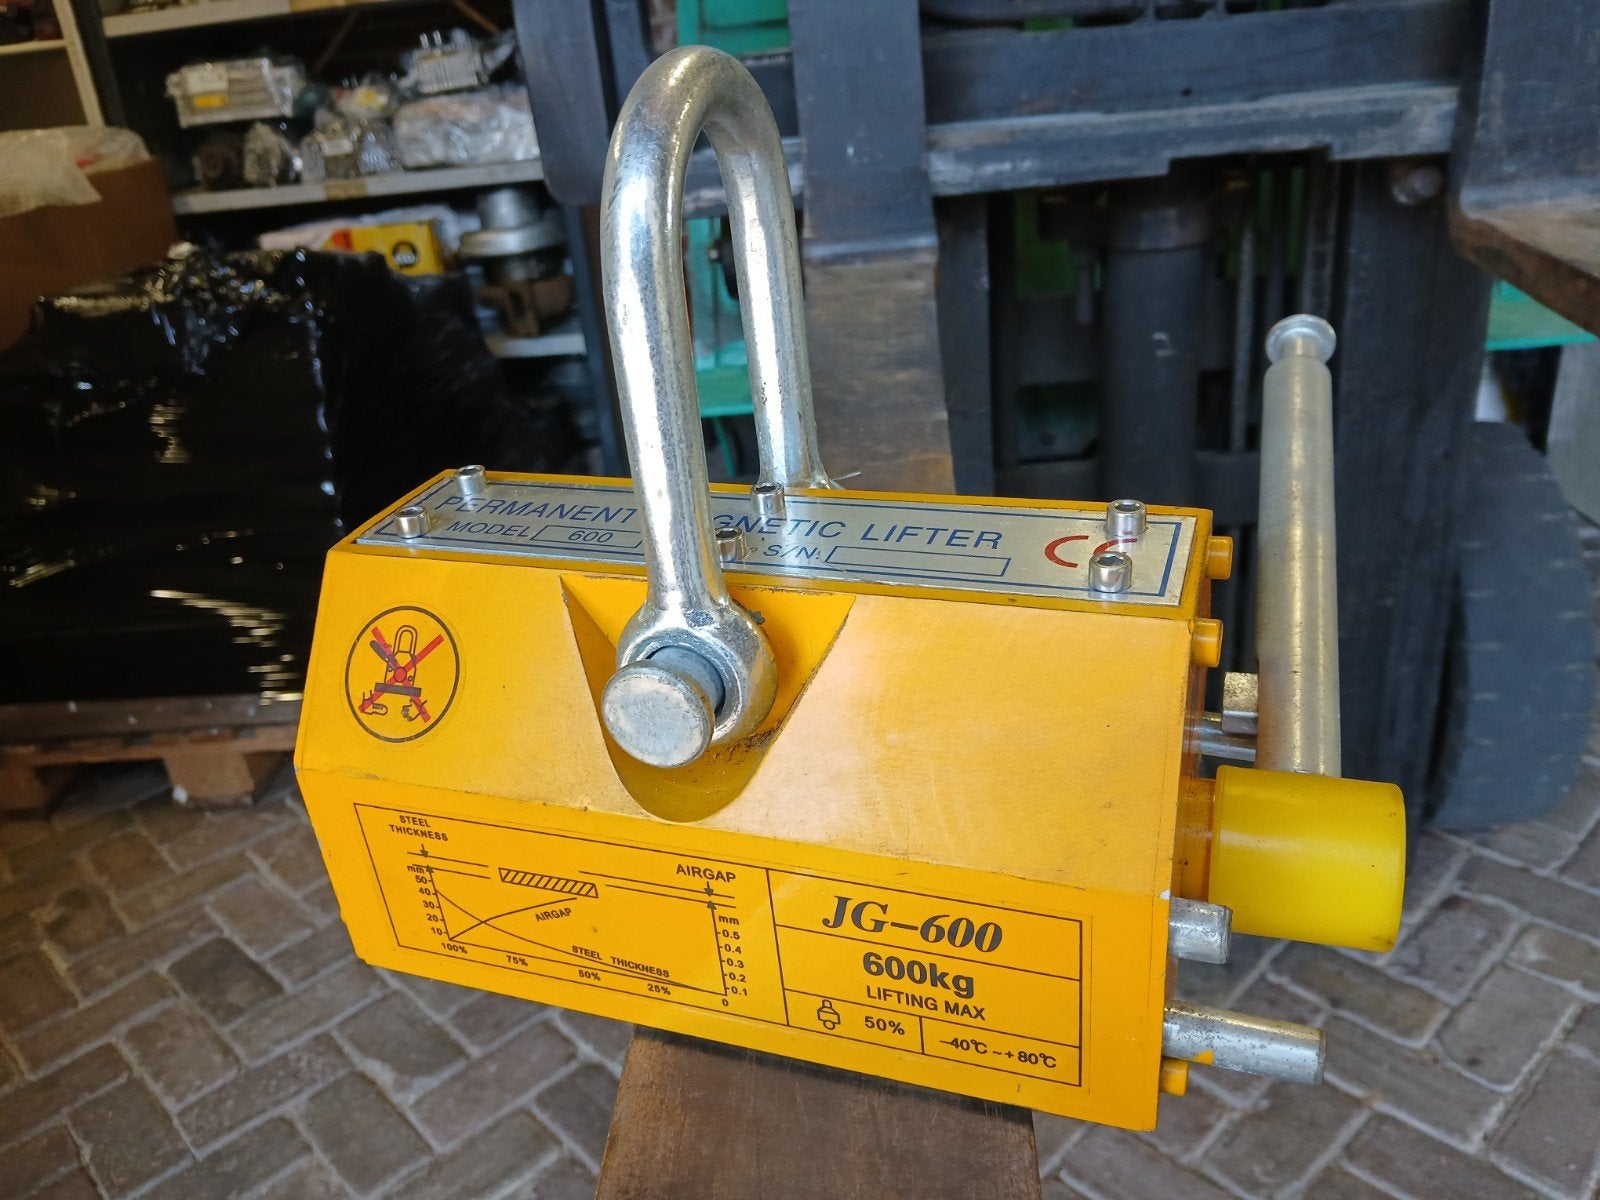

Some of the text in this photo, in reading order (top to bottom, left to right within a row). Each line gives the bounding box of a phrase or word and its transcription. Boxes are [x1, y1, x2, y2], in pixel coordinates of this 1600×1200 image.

[446, 521, 531, 538] MODEL
[568, 530, 613, 543] 600
[713, 514, 846, 539] GNETIC
[860, 523, 1003, 550] LIFTER
[399, 815, 431, 828] STEEL
[389, 824, 448, 841] THICKNESS
[407, 865, 424, 874] mm
[675, 863, 736, 883] AIRGAP
[415, 875, 427, 885] 50
[418, 886, 431, 896] 40
[422, 899, 435, 909] 30
[426, 913, 439, 922] 20
[535, 907, 572, 921] AIRGAP
[718, 914, 740, 925] mm
[822, 895, 1003, 952] JG-600
[430, 926, 443, 936] 10
[722, 929, 740, 940] 0.5
[724, 943, 742, 954] 0.4
[572, 945, 670, 978] STEEL THICKNESS
[726, 958, 744, 969] 0.3
[441, 942, 729, 1007] 100% 75% 50% 25% 0
[729, 972, 746, 982] 0.2
[863, 951, 975, 999] 600kg
[731, 985, 748, 996] 0.1
[866, 985, 986, 1020] LIFTING MAX
[864, 1015, 905, 1035] 50%
